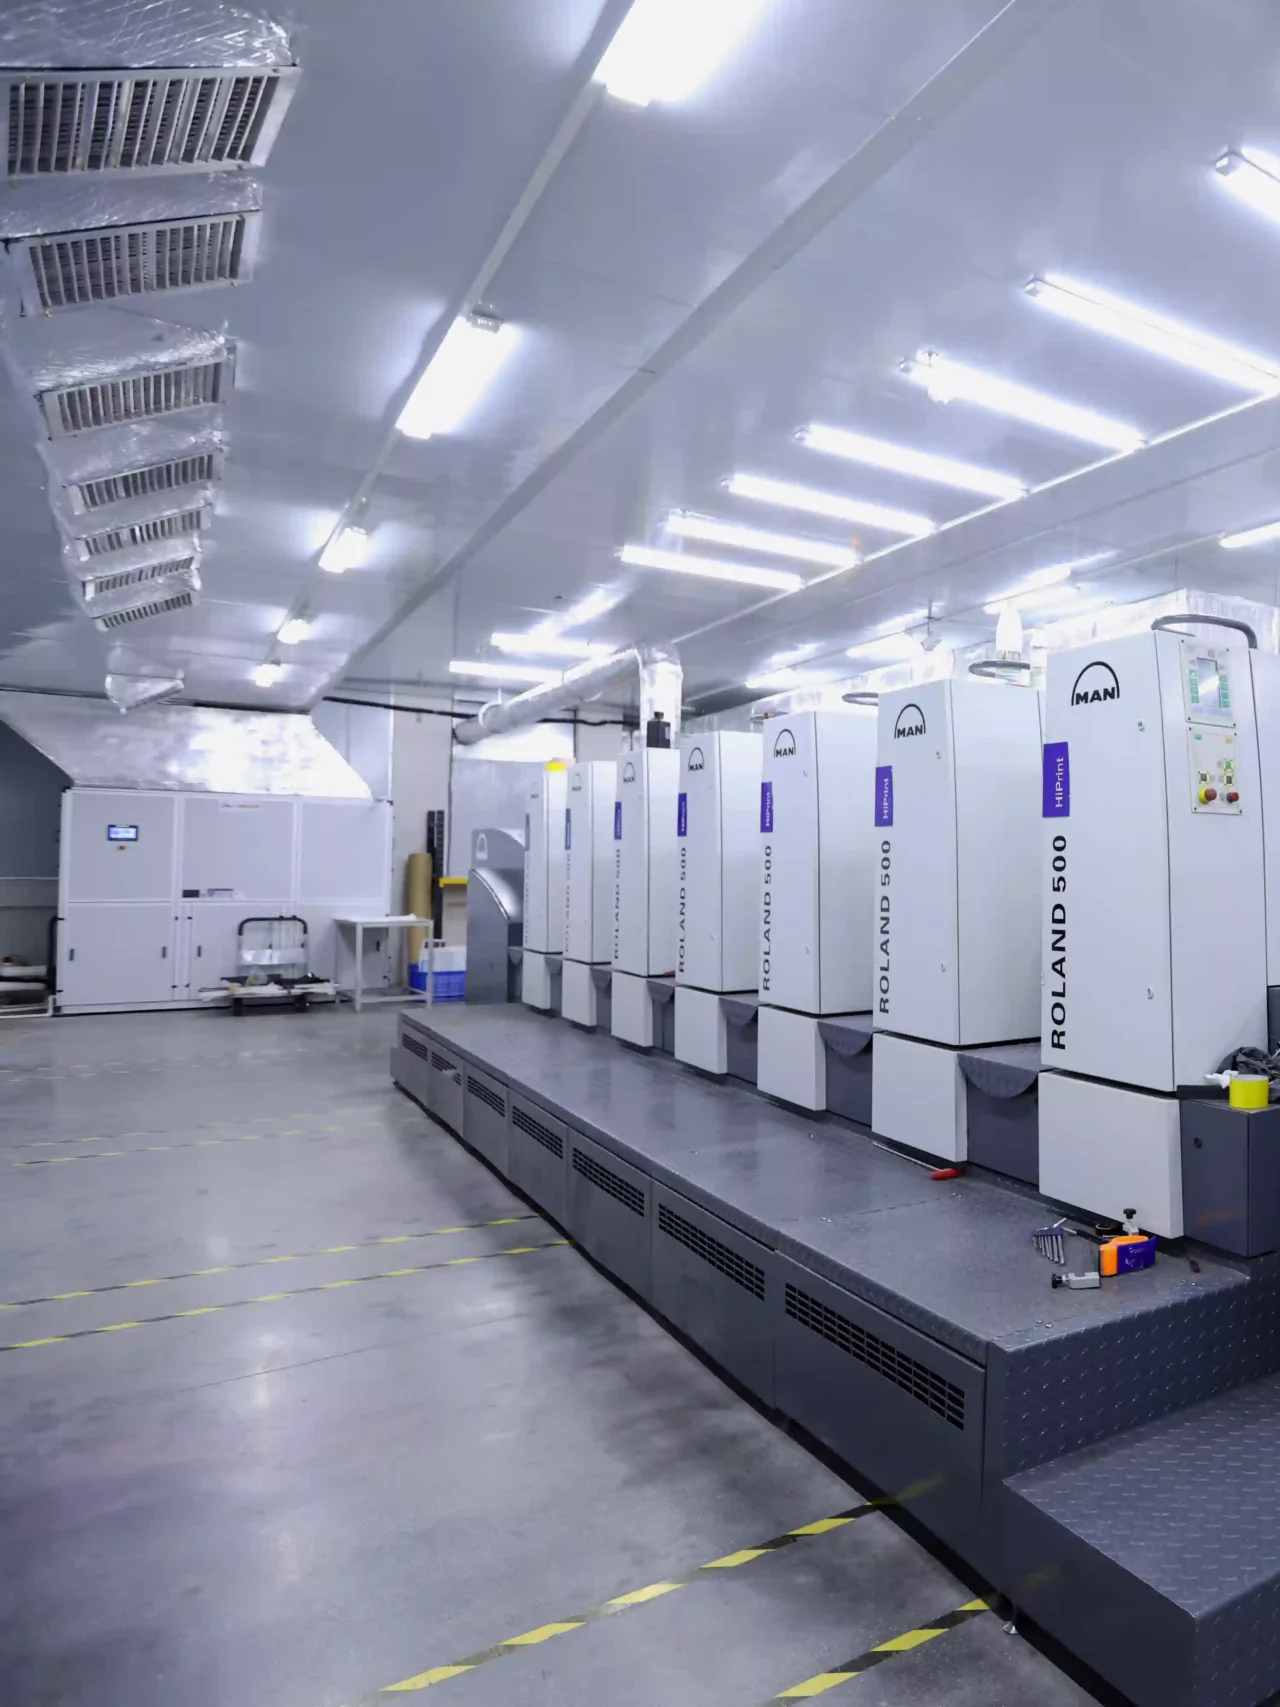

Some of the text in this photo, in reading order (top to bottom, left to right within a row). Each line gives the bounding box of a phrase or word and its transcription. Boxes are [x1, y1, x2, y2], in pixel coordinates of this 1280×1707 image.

[1075, 686, 1117, 705] MAN
[776, 747, 794, 758] MAN
[897, 724, 924, 739] MAN
[1055, 756, 1065, 808] HiPrint
[763, 845, 772, 991] ROLAND 500
[879, 840, 891, 1014] ROLAND 500
[1051, 835, 1067, 1050] ROLAND 500
